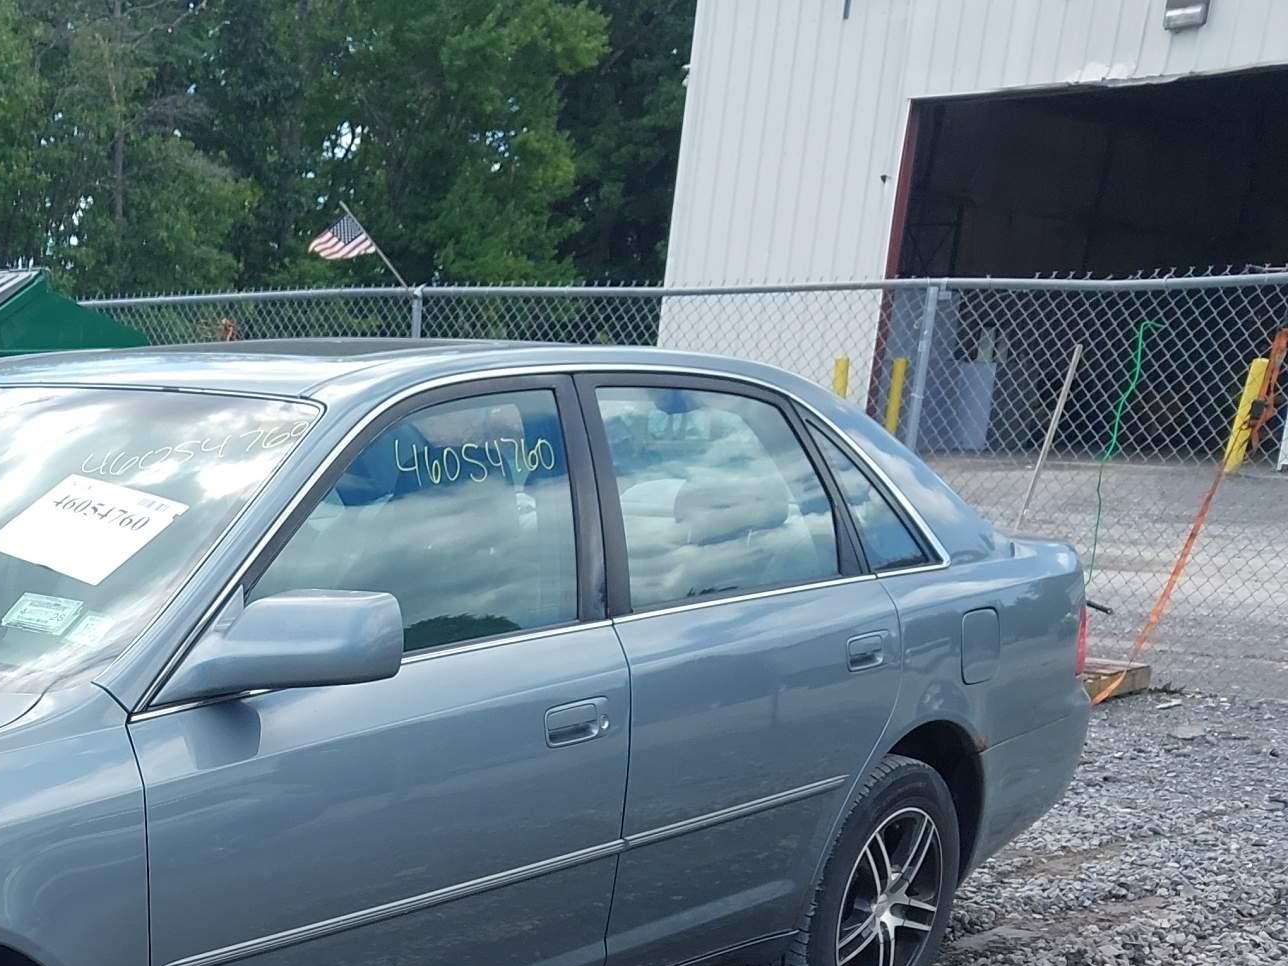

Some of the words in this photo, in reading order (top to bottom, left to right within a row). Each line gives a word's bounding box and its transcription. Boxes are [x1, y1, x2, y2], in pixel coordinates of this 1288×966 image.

[81, 421, 309, 475] 46054760
[394, 438, 555, 487] 46054760
[53, 495, 151, 532] 46054760
